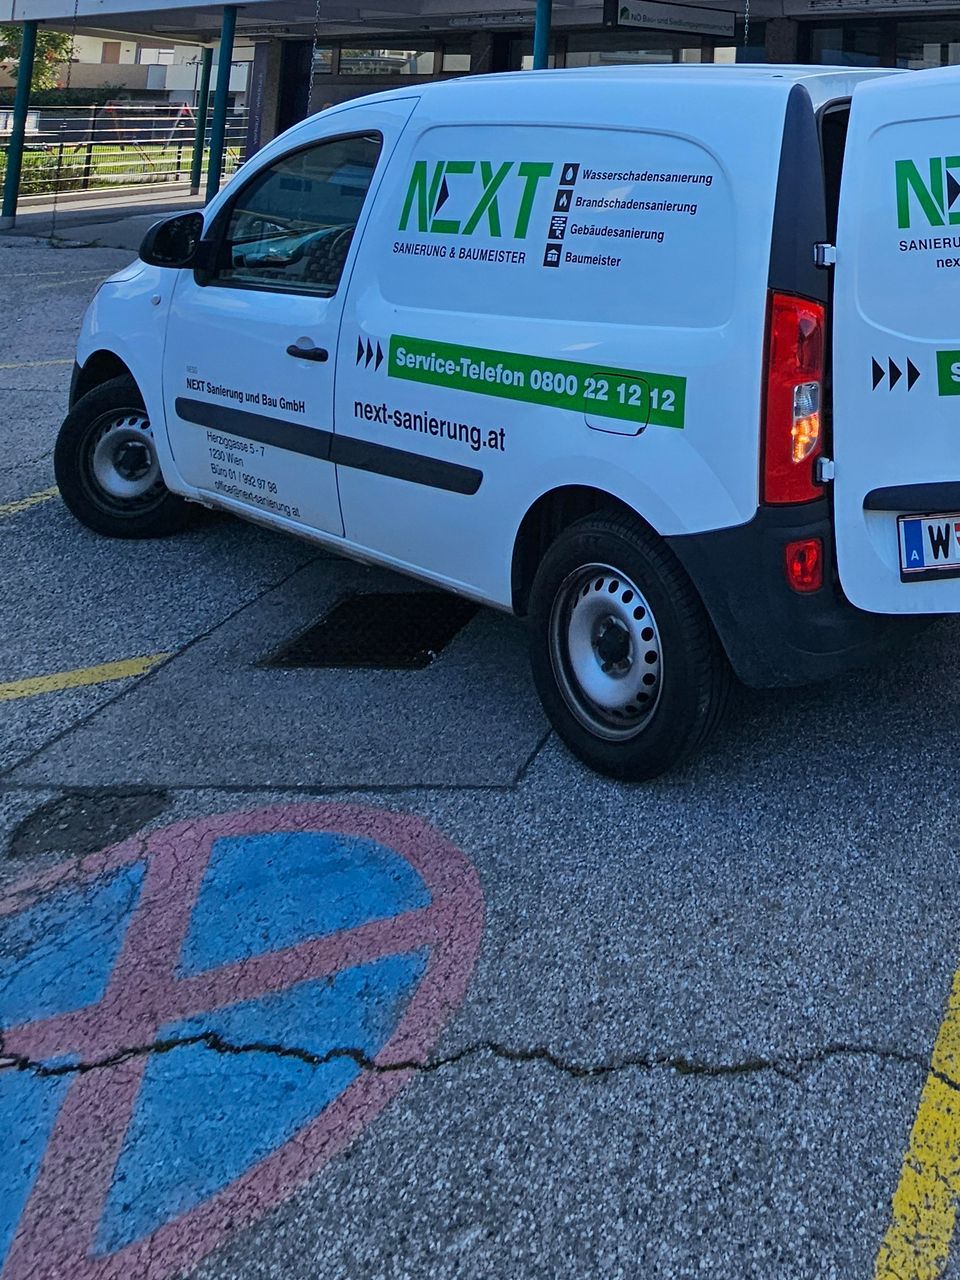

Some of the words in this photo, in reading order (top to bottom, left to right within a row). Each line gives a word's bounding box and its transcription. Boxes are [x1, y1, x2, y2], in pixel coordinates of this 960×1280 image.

[582, 169, 713, 186] Wasserschadensanierung
[398, 161, 554, 240] NEXT
[575, 196, 698, 215] Brandschadensanierung
[570, 223, 665, 243] Gebäudesanierung
[392, 242, 447, 258] SANIERUNG
[449, 247, 456, 258] &
[458, 248, 526, 264] BAUMEISTER
[565, 251, 621, 267] Baumeister
[396, 347, 525, 387] Service-Telefon
[530, 369, 578, 396] 0800
[583, 377, 609, 400] 22
[616, 383, 642, 406] 12
[649, 388, 676, 412] 12
[186, 377, 205, 392] NEXT
[206, 382, 244, 403] Sanierung
[245, 392, 260, 404] und
[261, 394, 277, 408] Bau
[279, 397, 306, 413] GmbH
[353, 400, 506, 452] next-sanierung.at
[209, 447, 226, 462] 1230
[226, 452, 244, 467] Wien
[249, 443, 255, 454] 5
[260, 446, 265, 457] 7
[210, 463, 228, 478] Büro
[228, 468, 237, 481] 01
[257, 478, 266, 490] 97
[910, 550, 920, 561] A
